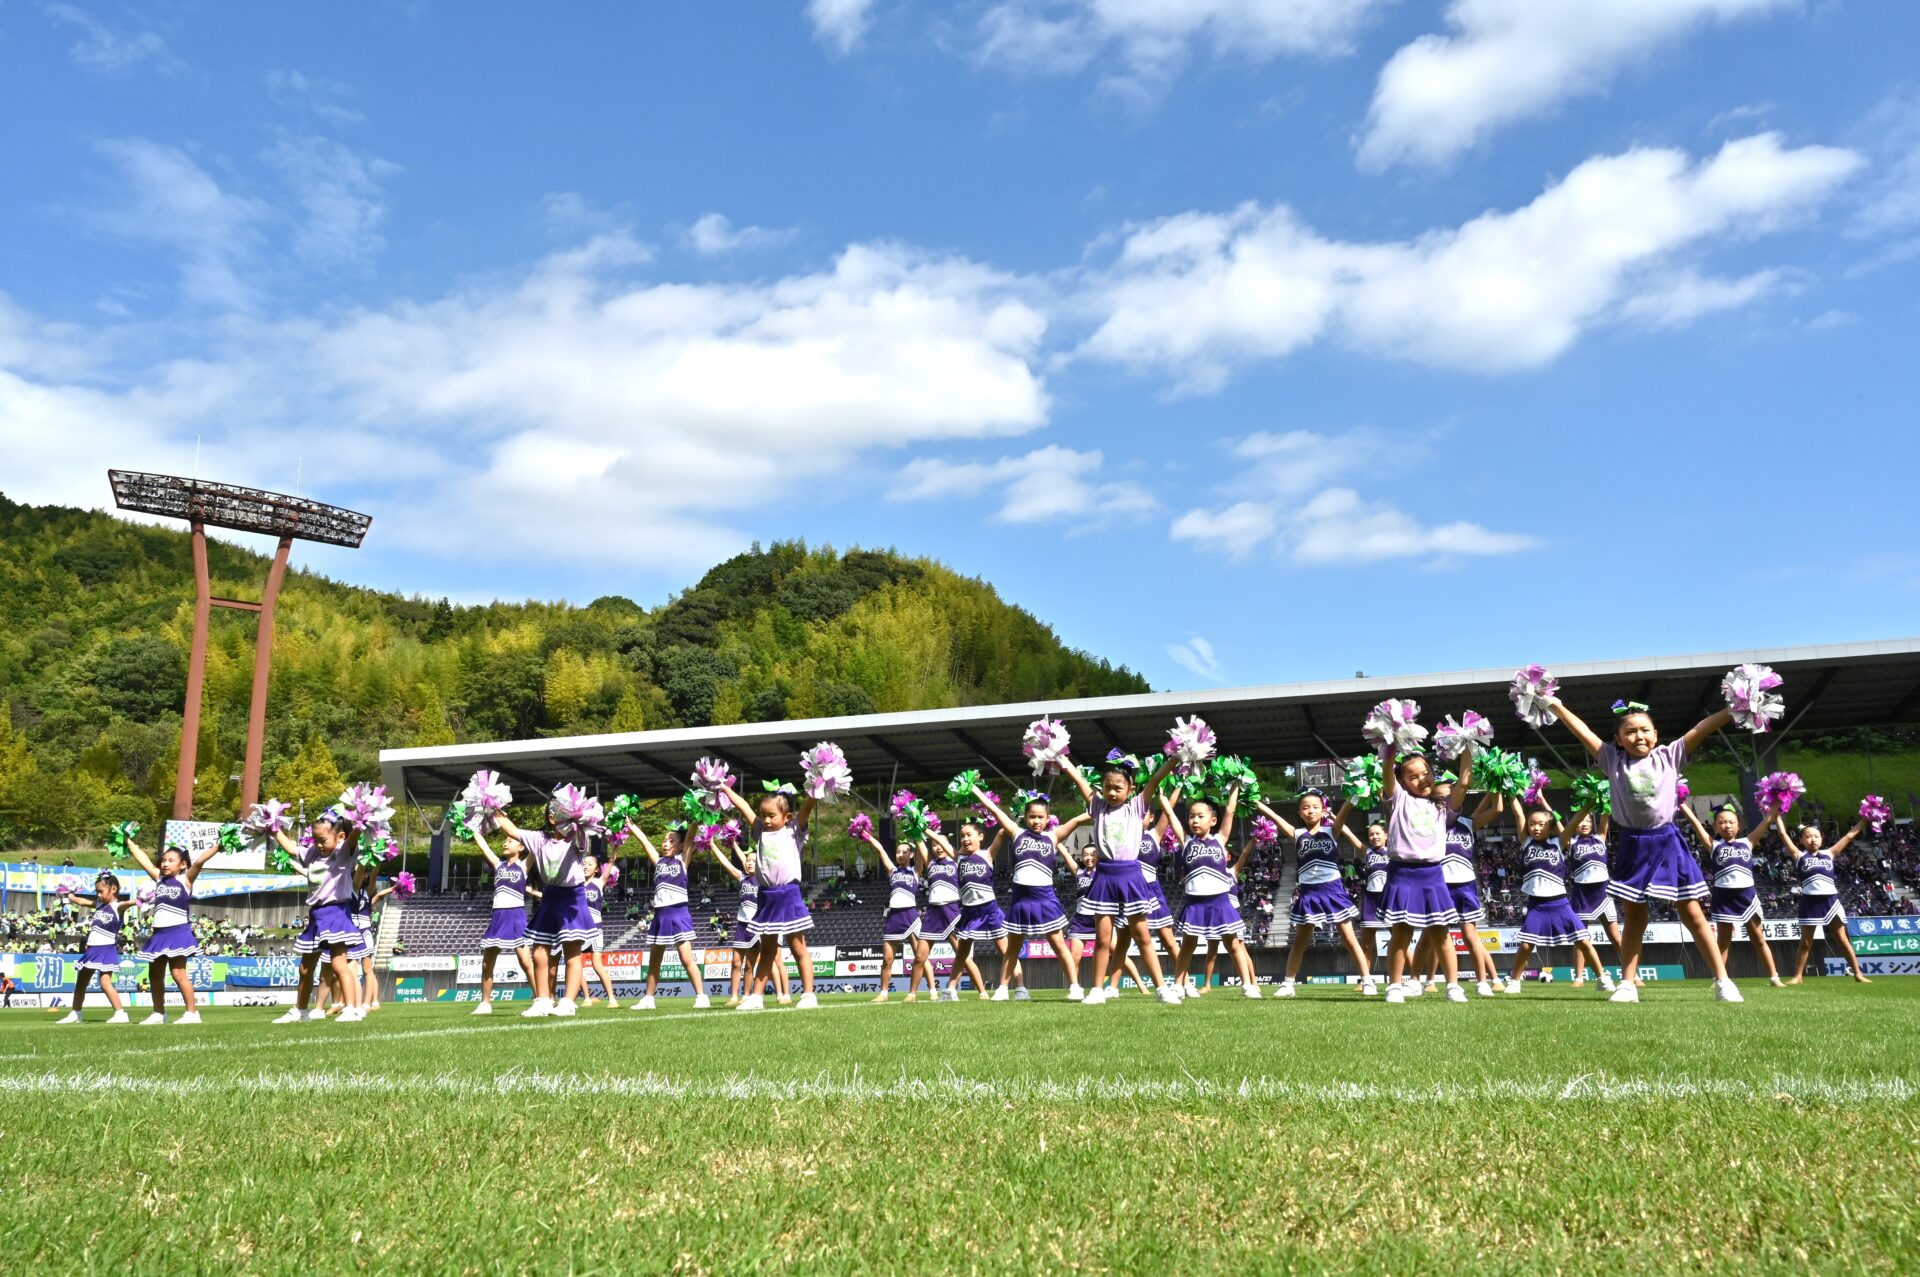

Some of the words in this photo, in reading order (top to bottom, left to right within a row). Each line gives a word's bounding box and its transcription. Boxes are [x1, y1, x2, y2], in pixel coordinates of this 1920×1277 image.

[1017, 838, 1052, 855] Blossy
[1300, 838, 1331, 855] Blossy
[1446, 832, 1471, 848] lossy
[1186, 845, 1221, 862] Blossy
[1524, 848, 1559, 866] Blossy
[1575, 844, 1605, 858] Blossy
[1718, 847, 1751, 862] Blossy
[655, 863, 681, 878] Blossy
[929, 864, 955, 877] Blossy
[960, 864, 986, 877] Blossy
[1802, 858, 1832, 871] Blossy
[495, 868, 521, 883] Blossy
[892, 872, 913, 885] Blossy
[1079, 877, 1092, 888] Blo
[586, 889, 599, 902] ssy
[607, 953, 640, 965] K-MIX
